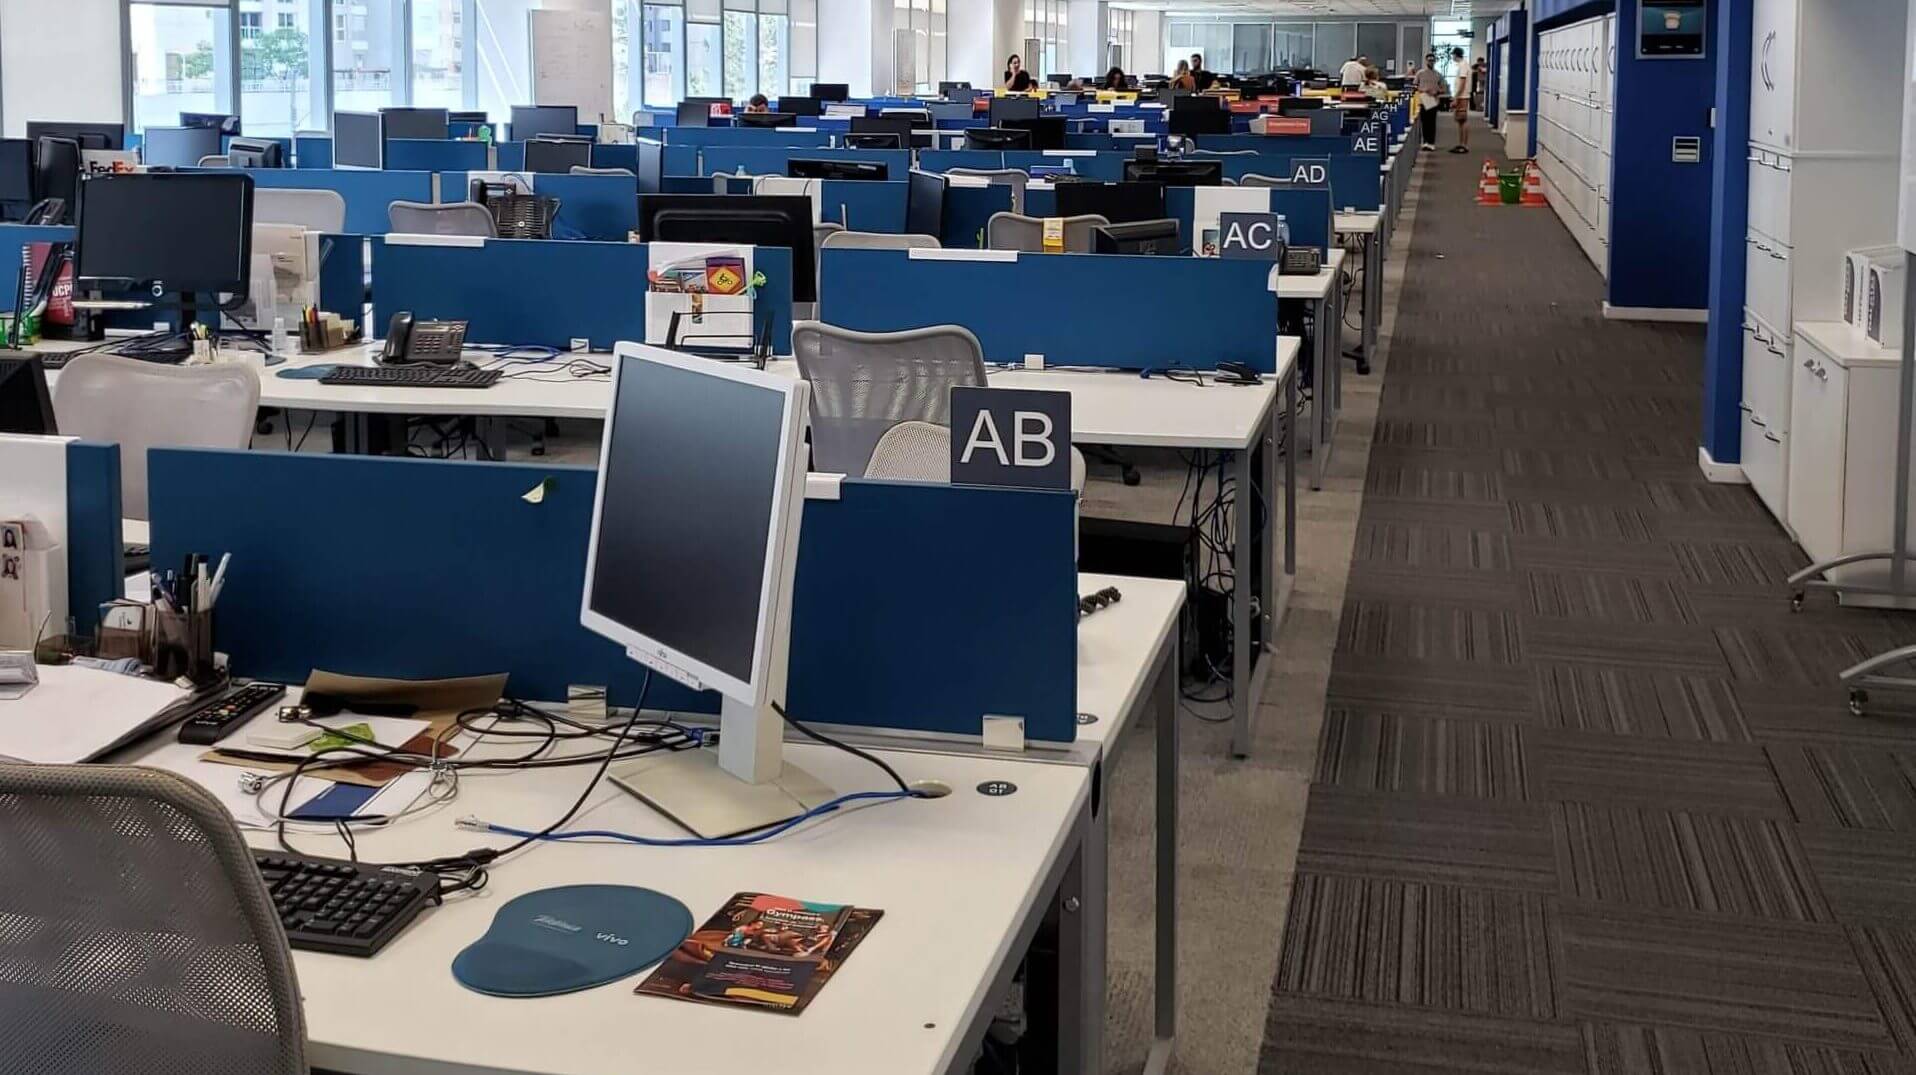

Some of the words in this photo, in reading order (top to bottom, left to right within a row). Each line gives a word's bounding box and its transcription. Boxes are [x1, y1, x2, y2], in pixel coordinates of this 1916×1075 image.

[1383, 103, 1398, 112] AH
[1371, 110, 1389, 121] AG
[1360, 121, 1380, 133] AF
[1353, 136, 1378, 151] AE
[1292, 164, 1326, 183] AD
[1223, 221, 1272, 250] AC
[960, 409, 1056, 467] AB
[596, 931, 629, 946] vivo
